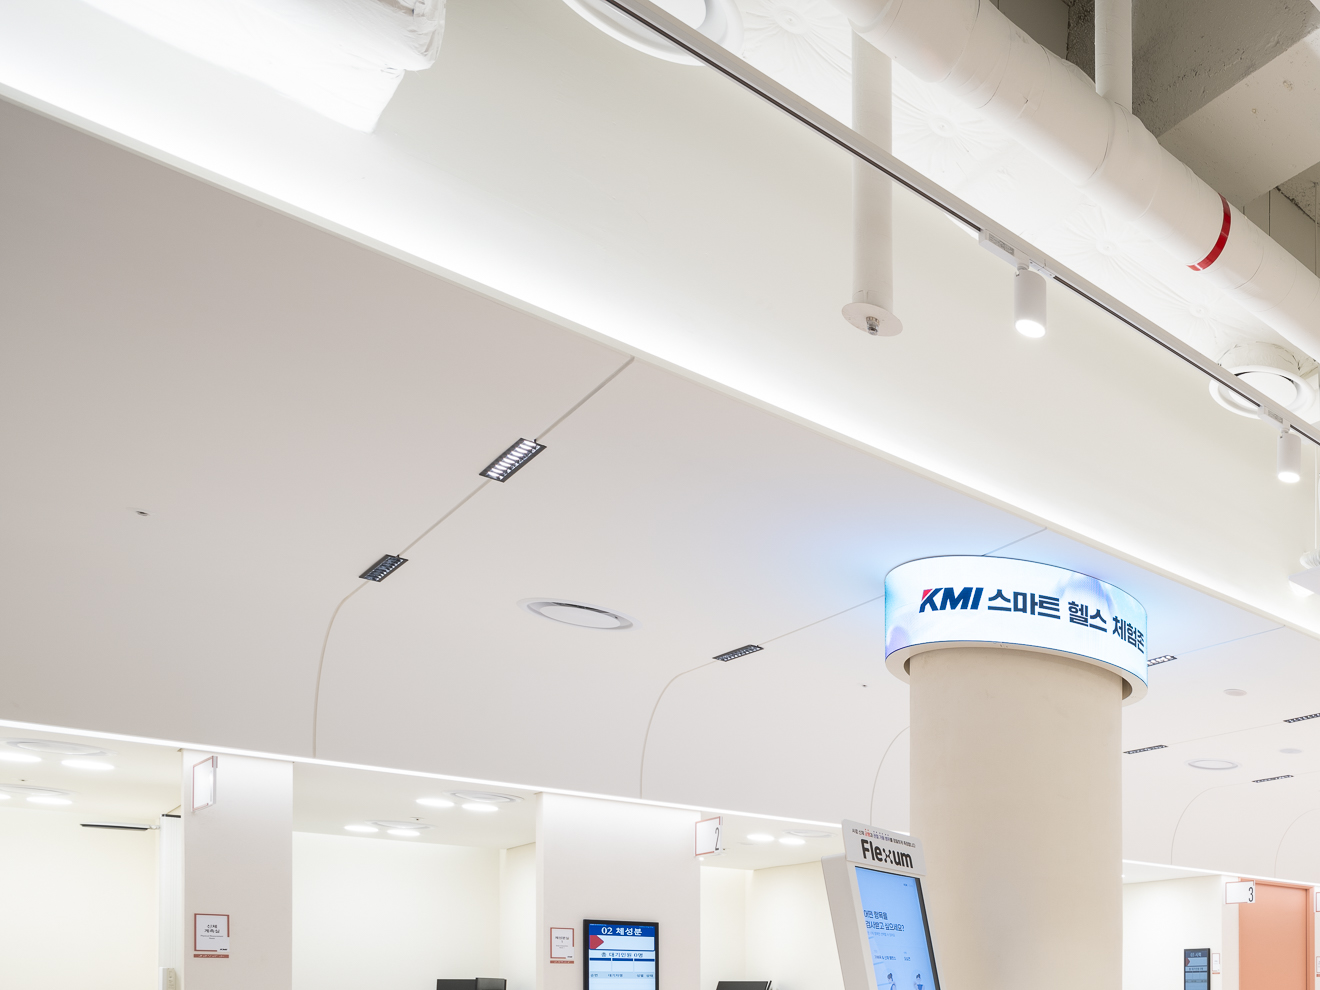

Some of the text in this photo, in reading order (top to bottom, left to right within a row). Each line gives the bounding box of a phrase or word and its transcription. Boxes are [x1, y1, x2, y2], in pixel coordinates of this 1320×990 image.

[919, 586, 1145, 654] KMI 스마트 헬스 체험존
[715, 827, 719, 851] 2
[861, 838, 914, 869] Flexum
[1248, 886, 1253, 902] 3
[601, 927, 643, 936] 02 체성분
[865, 920, 905, 932] 검사받고 싶으세요?
